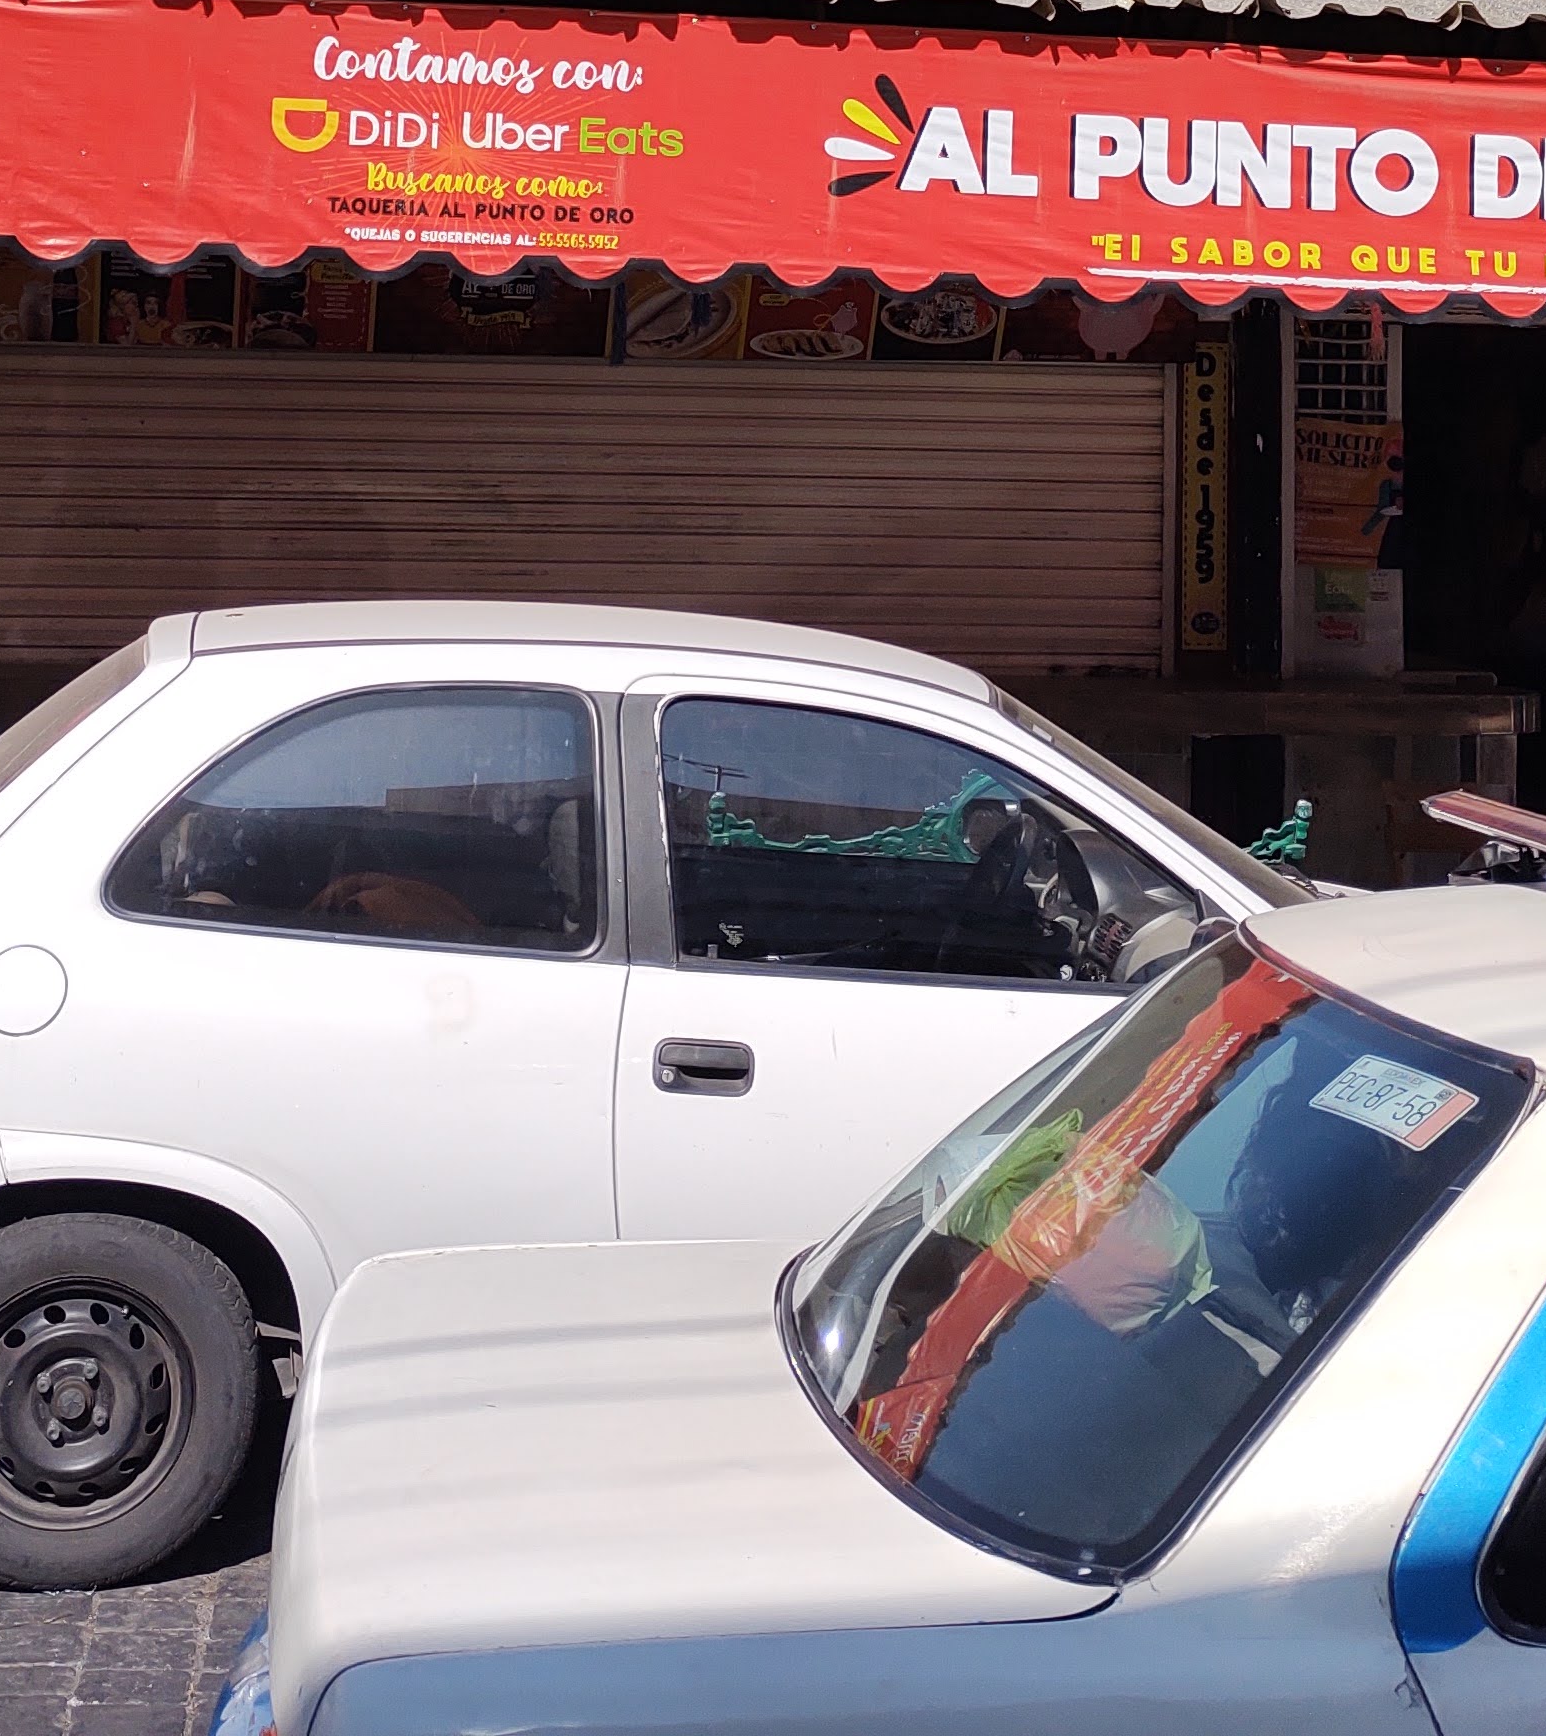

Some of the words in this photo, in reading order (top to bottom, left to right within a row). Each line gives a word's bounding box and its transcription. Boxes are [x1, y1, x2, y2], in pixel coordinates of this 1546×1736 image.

[313, 35, 544, 95] Contamos
[348, 110, 440, 149] DiDi
[463, 111, 570, 152] Uber
[579, 117, 684, 156] Eats
[367, 162, 510, 198] Buscanos
[898, 106, 1039, 199] AL
[1069, 113, 1438, 218] PUNTO
[328, 196, 430, 217] TAQUERIA
[439, 202, 466, 219] AL
[475, 203, 545, 222] PUNTO
[555, 205, 580, 223] DE
[590, 207, 635, 225] ORO
[405, 230, 416, 241] O
[420, 230, 512, 246] SUGERENCIAS
[1170, 237, 1322, 270] SABOR
[1353, 244, 1437, 276] QUE
[1466, 250, 1517, 278] TU
[1333, 1071, 1436, 1126] PEC-87-58
